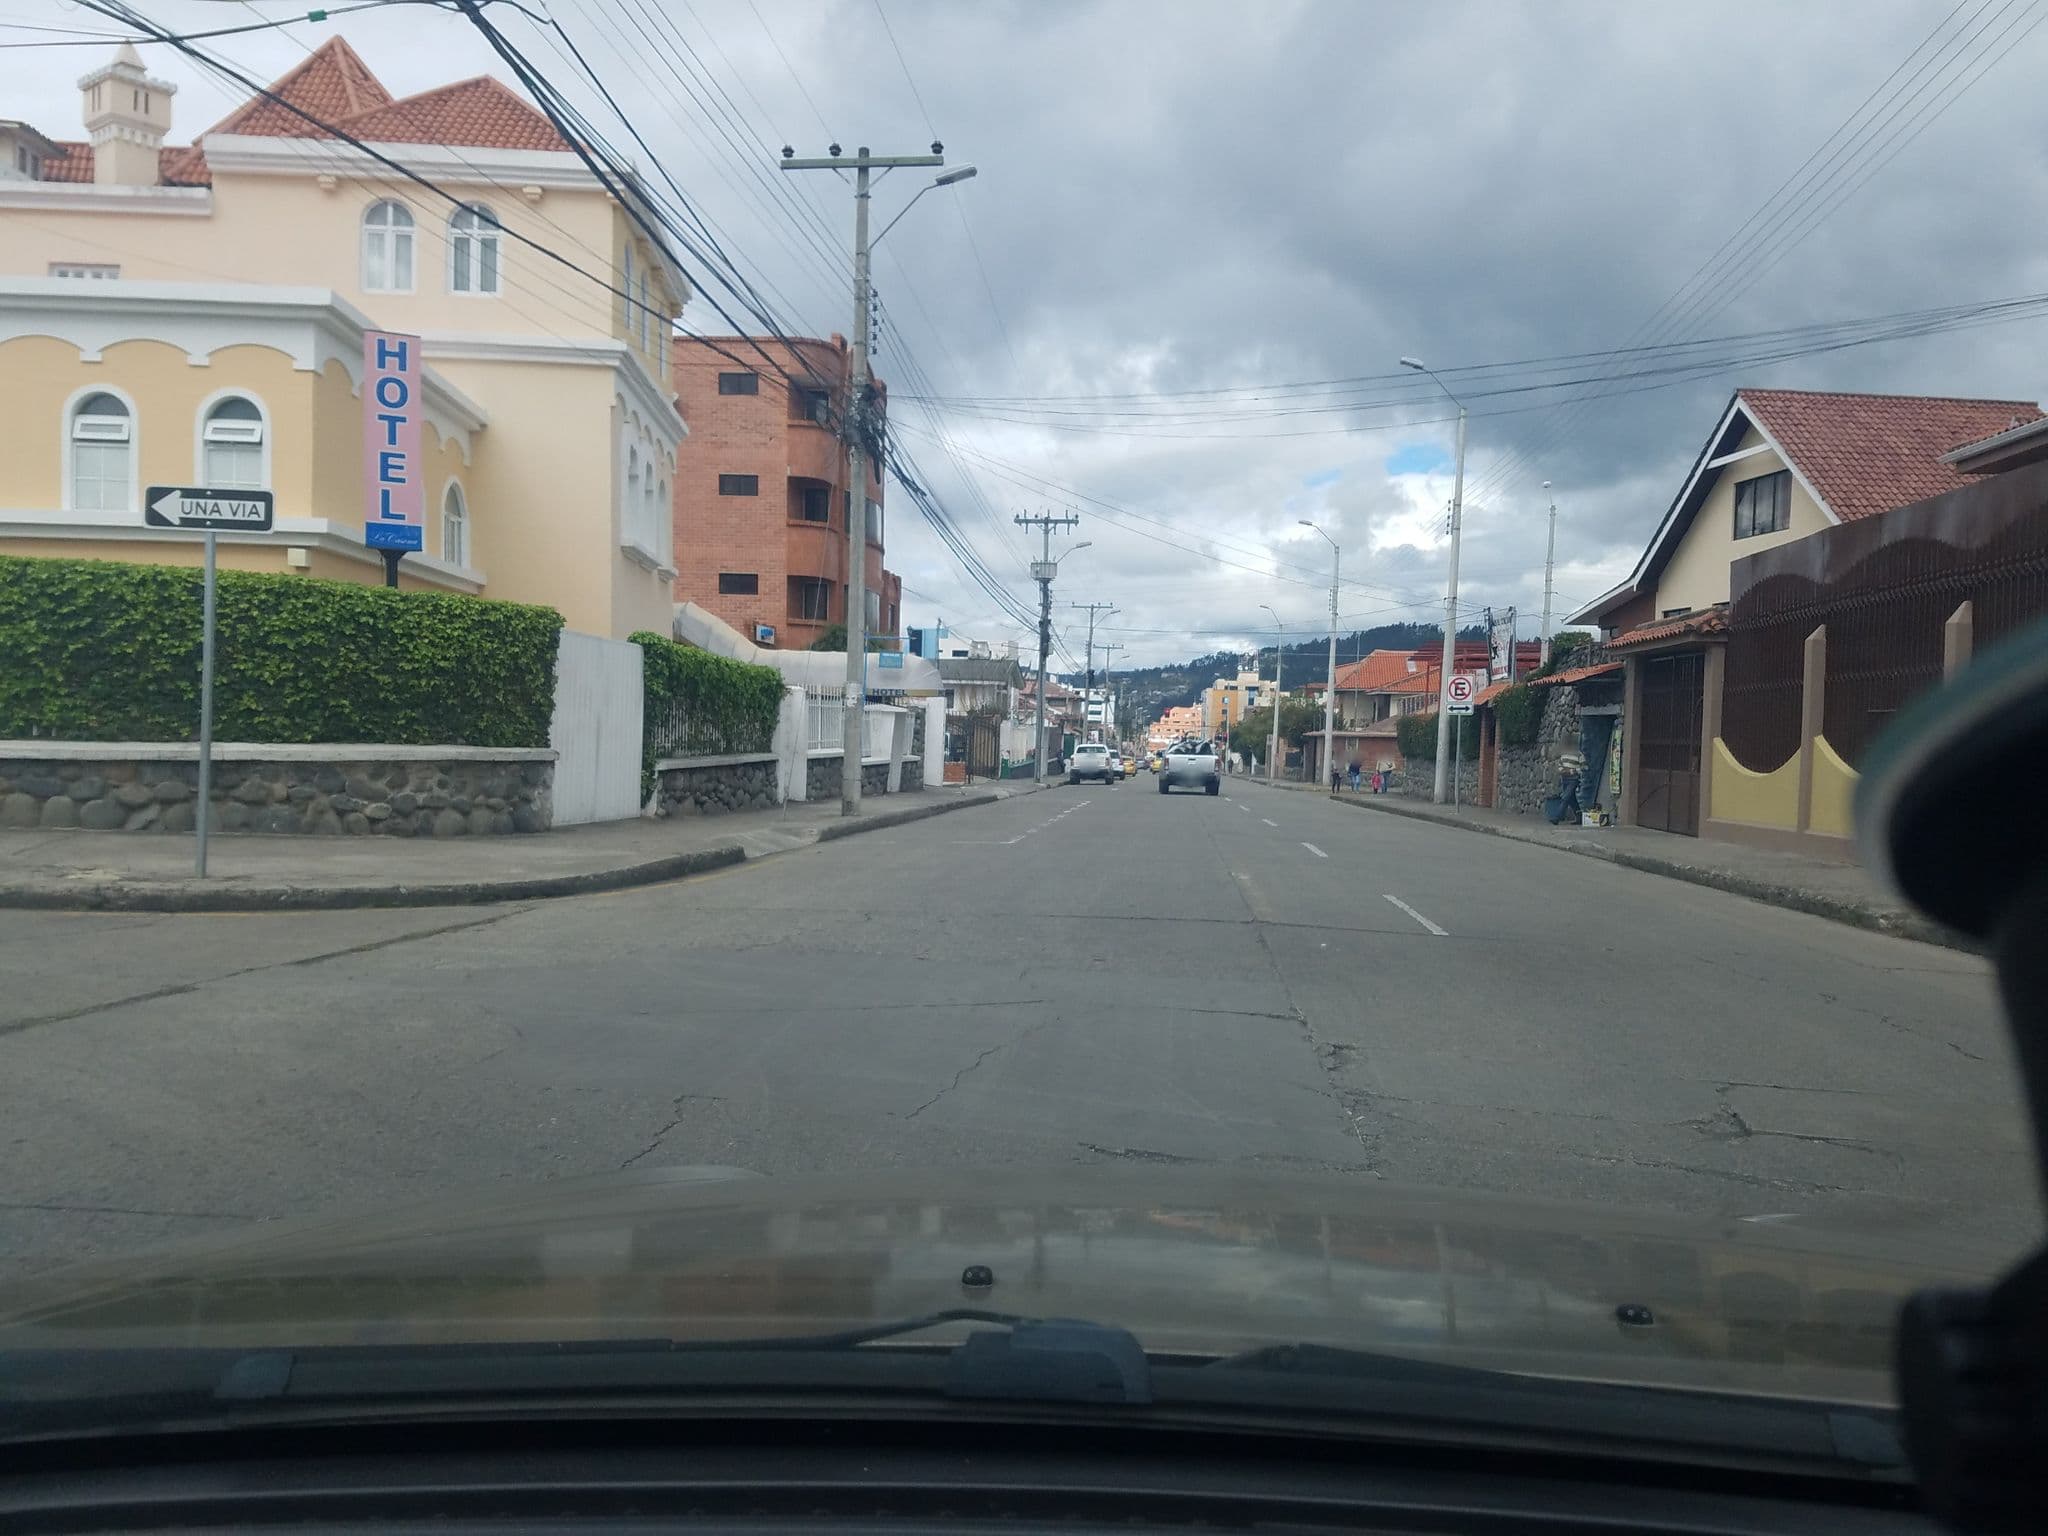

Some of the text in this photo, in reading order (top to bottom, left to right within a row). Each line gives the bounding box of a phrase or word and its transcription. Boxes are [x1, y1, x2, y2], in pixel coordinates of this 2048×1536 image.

[376, 338, 409, 520] HOTEL
[181, 500, 261, 518] UNA VIA
[872, 688, 908, 696] HOTEL
[1454, 682, 1466, 696] E
